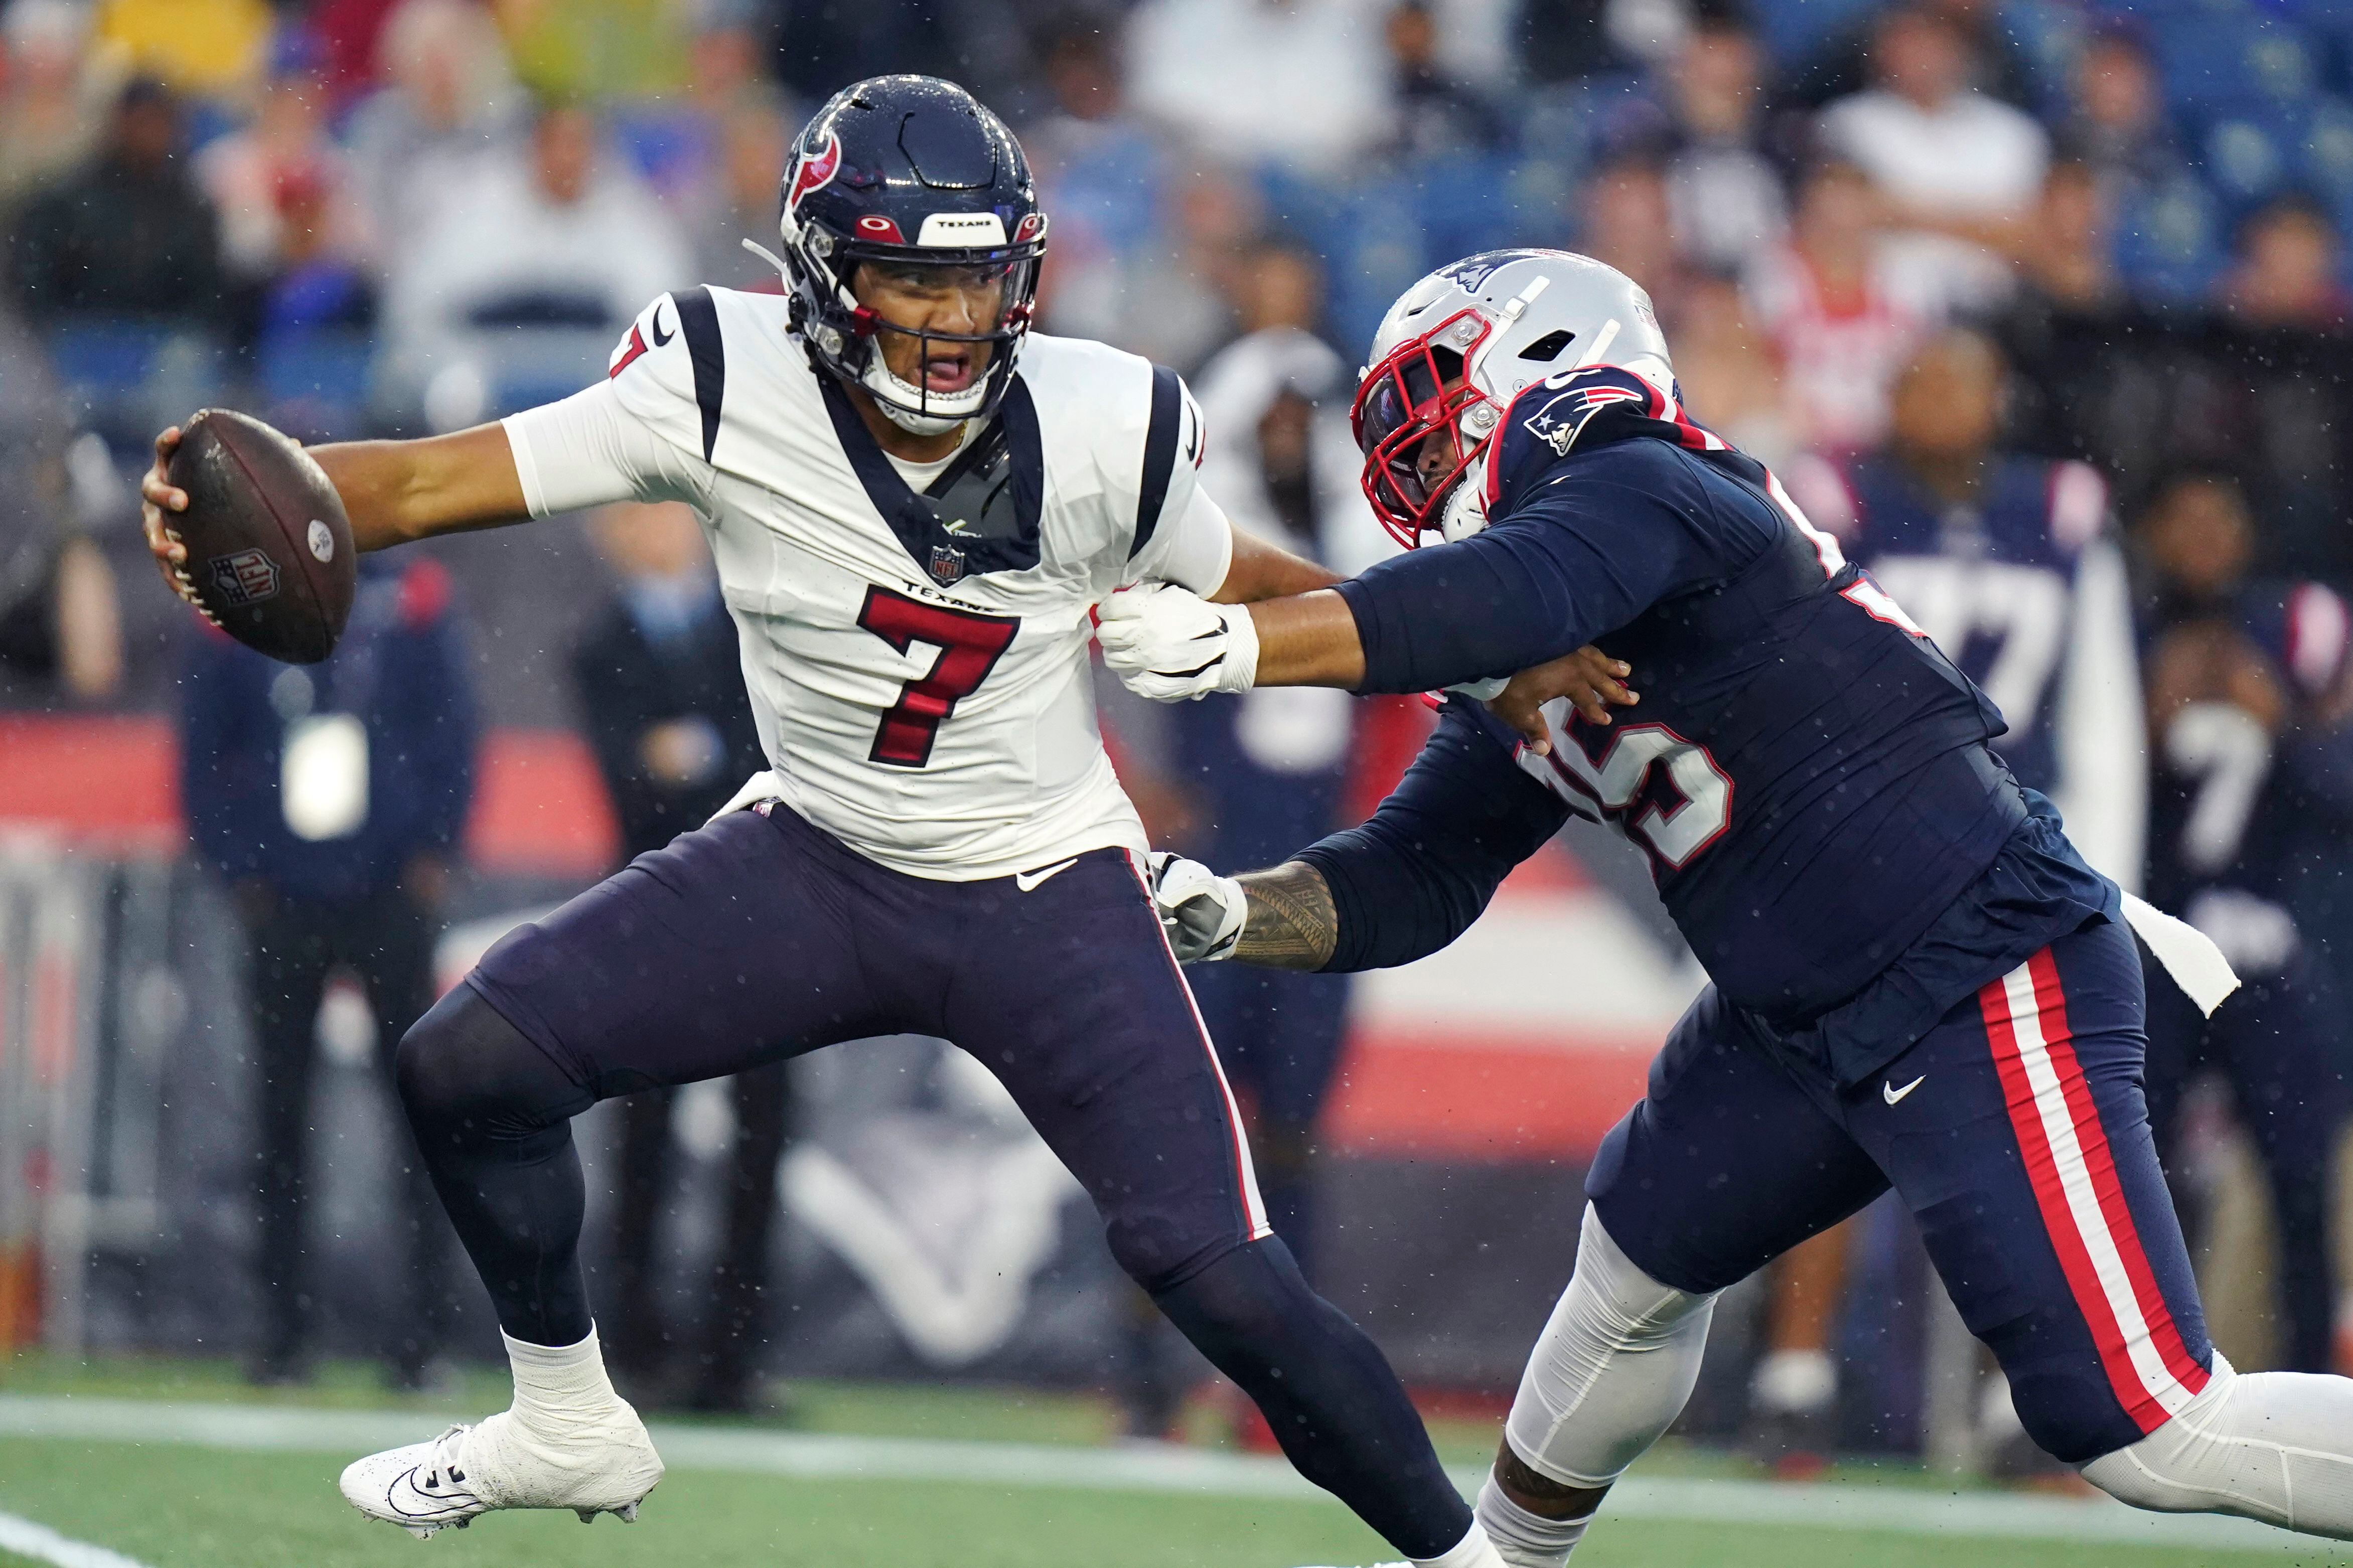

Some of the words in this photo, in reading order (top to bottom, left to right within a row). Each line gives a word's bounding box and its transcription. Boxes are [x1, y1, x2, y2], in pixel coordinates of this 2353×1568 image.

[610, 322, 649, 380] 7
[235, 555, 273, 596] NFL
[856, 583, 1022, 768] 7
[2163, 703, 2274, 874] 7
